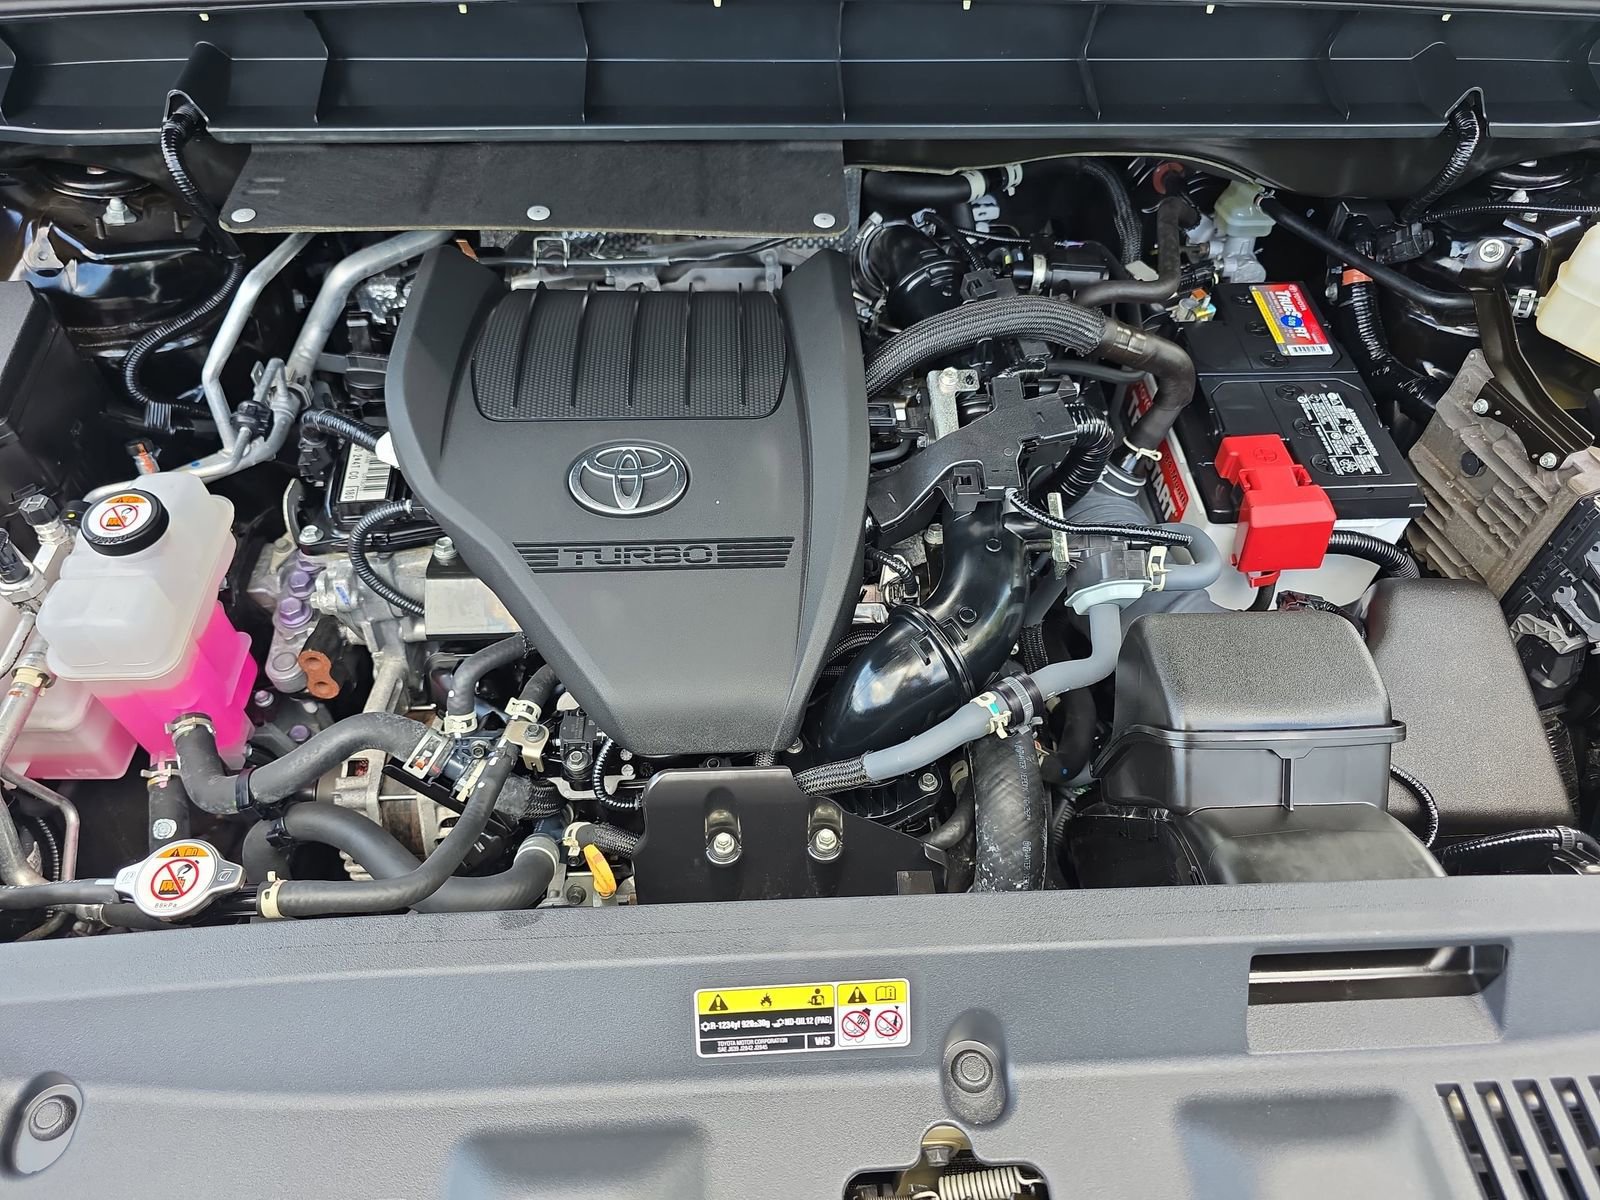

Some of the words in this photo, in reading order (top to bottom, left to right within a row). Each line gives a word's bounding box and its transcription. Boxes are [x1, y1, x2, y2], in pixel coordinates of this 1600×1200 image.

[563, 545, 713, 566] TURBO
[754, 1037, 788, 1046] CORPORATION
[814, 1036, 831, 1046] WS
